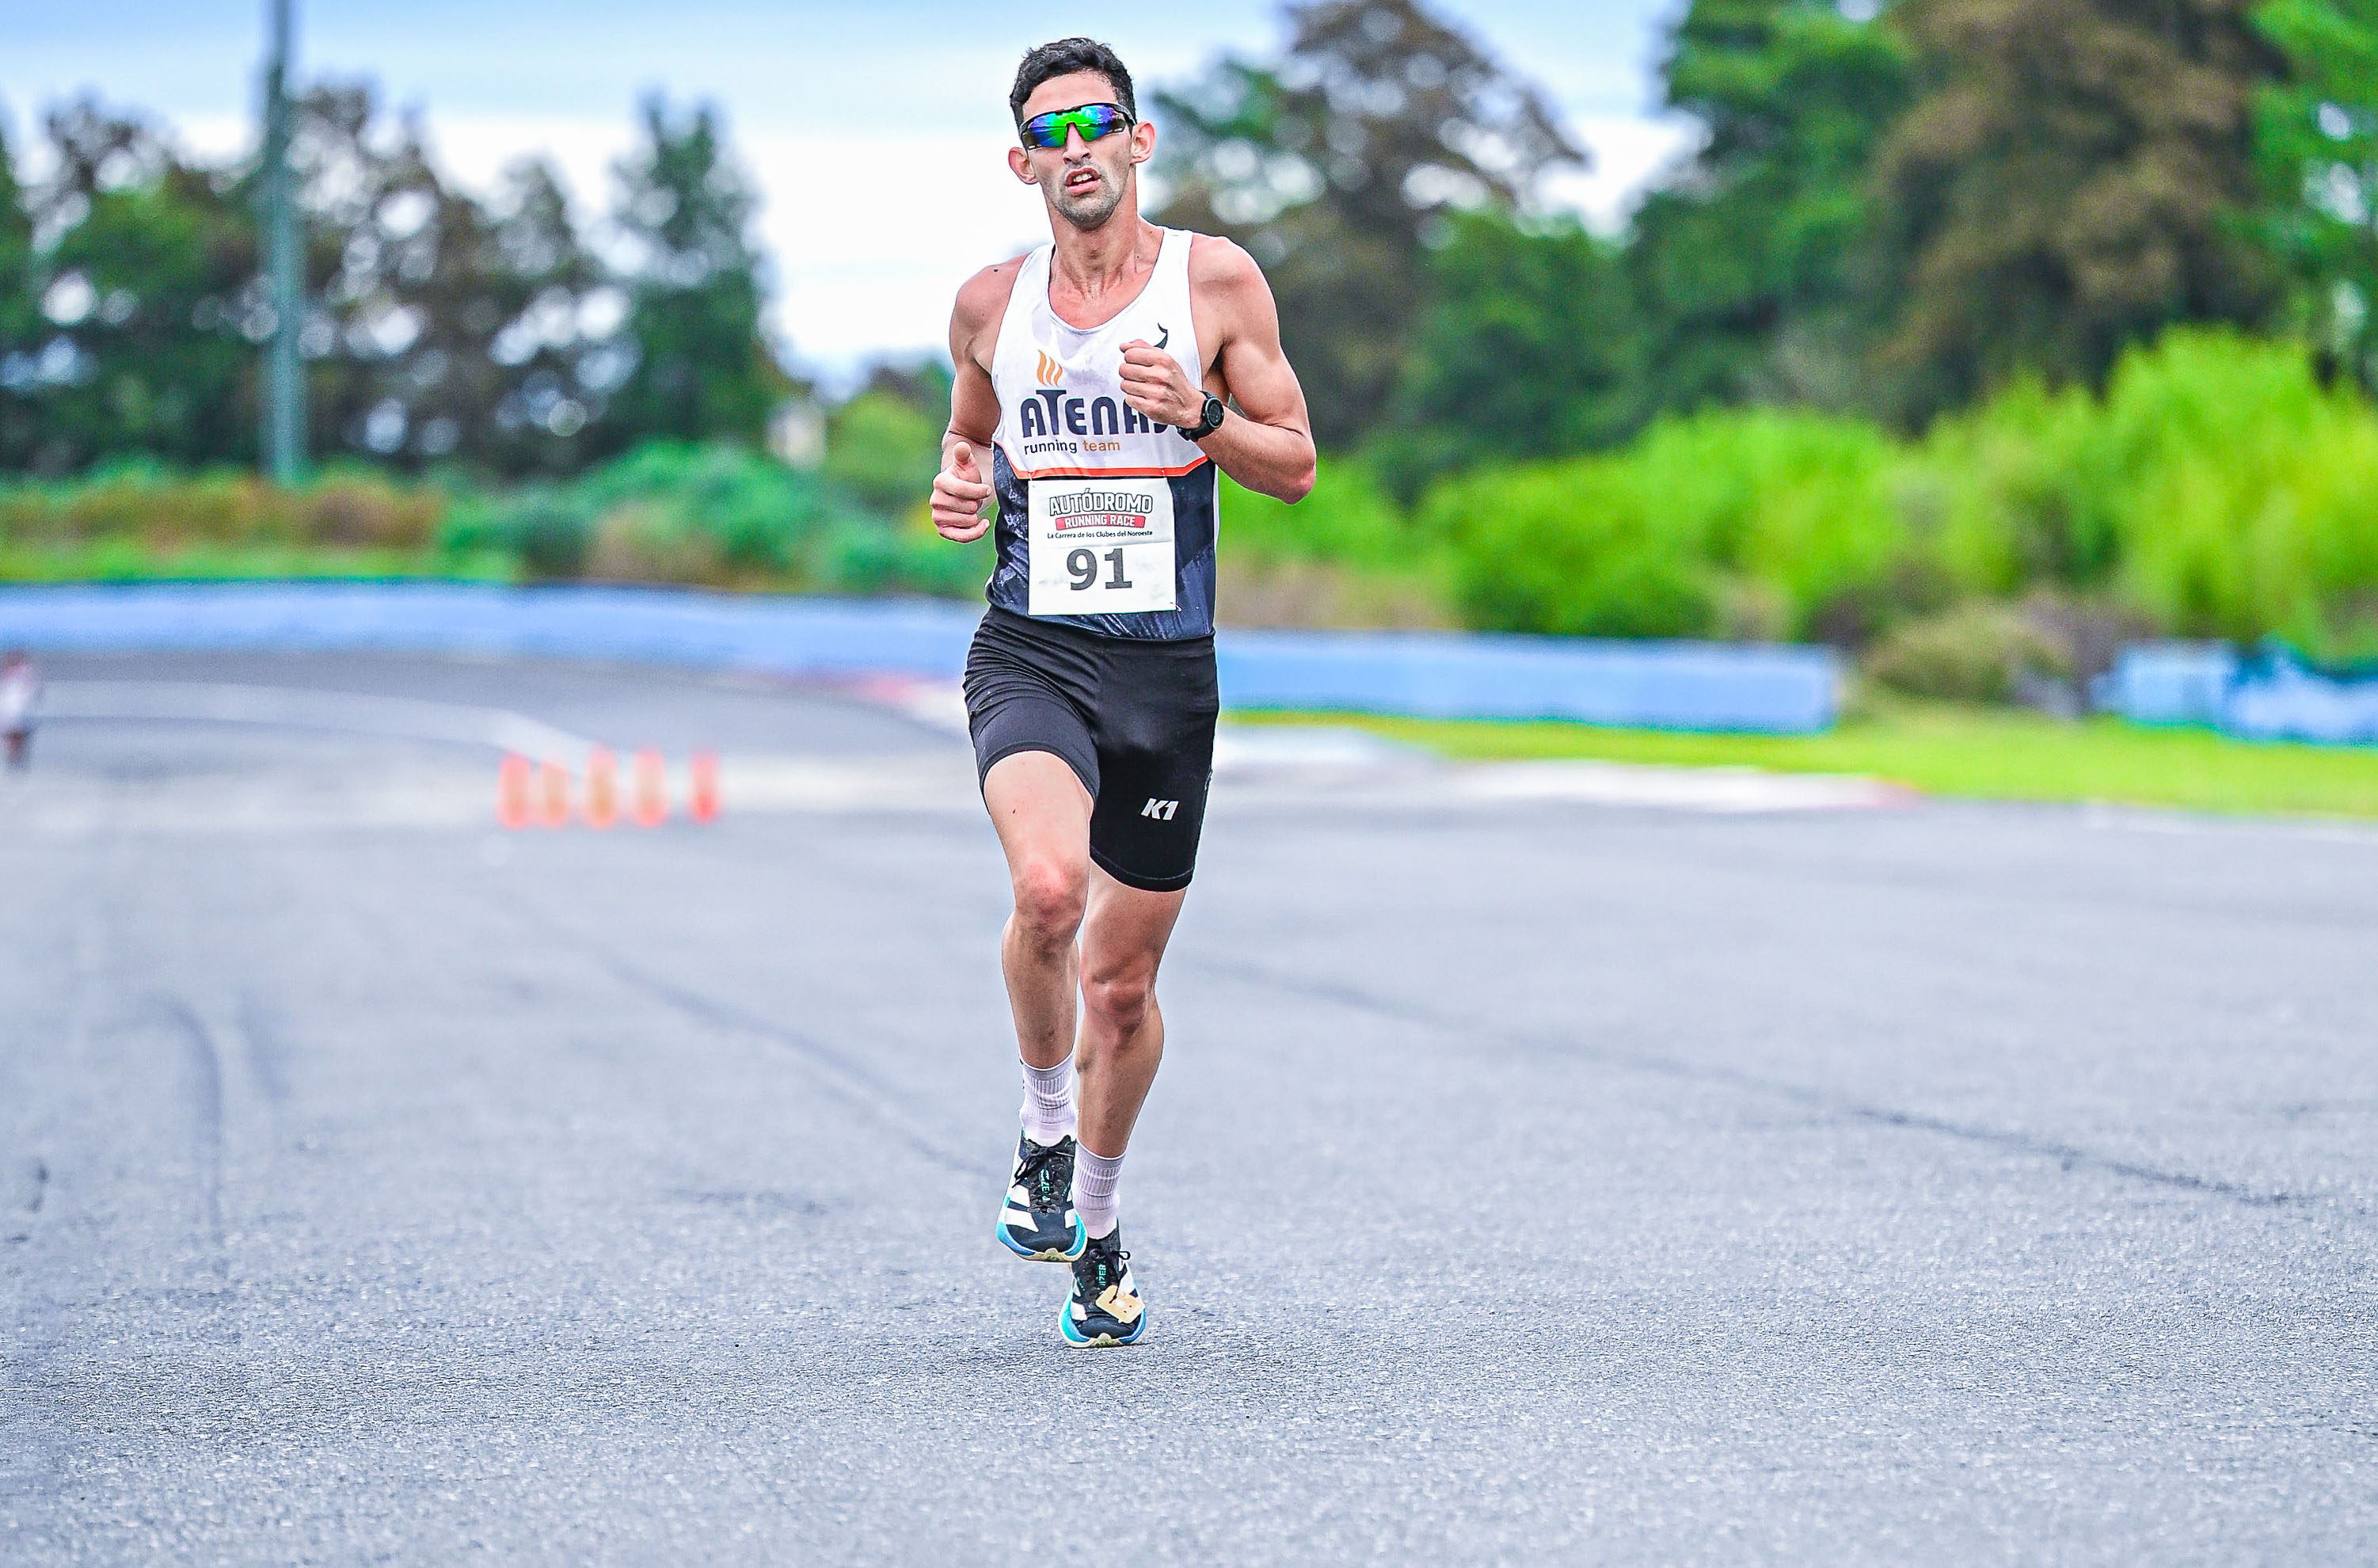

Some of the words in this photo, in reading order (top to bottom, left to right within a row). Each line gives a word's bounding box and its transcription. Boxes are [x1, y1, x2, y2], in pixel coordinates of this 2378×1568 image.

[1024, 440, 1077, 455] running
[1082, 440, 1121, 451] team
[1049, 488, 1153, 516] AUTÓDROMO
[1065, 515, 1107, 529] RUNNING
[1109, 515, 1136, 527] RACE
[1067, 548, 1132, 591] 91
[1140, 797, 1179, 820] K1
